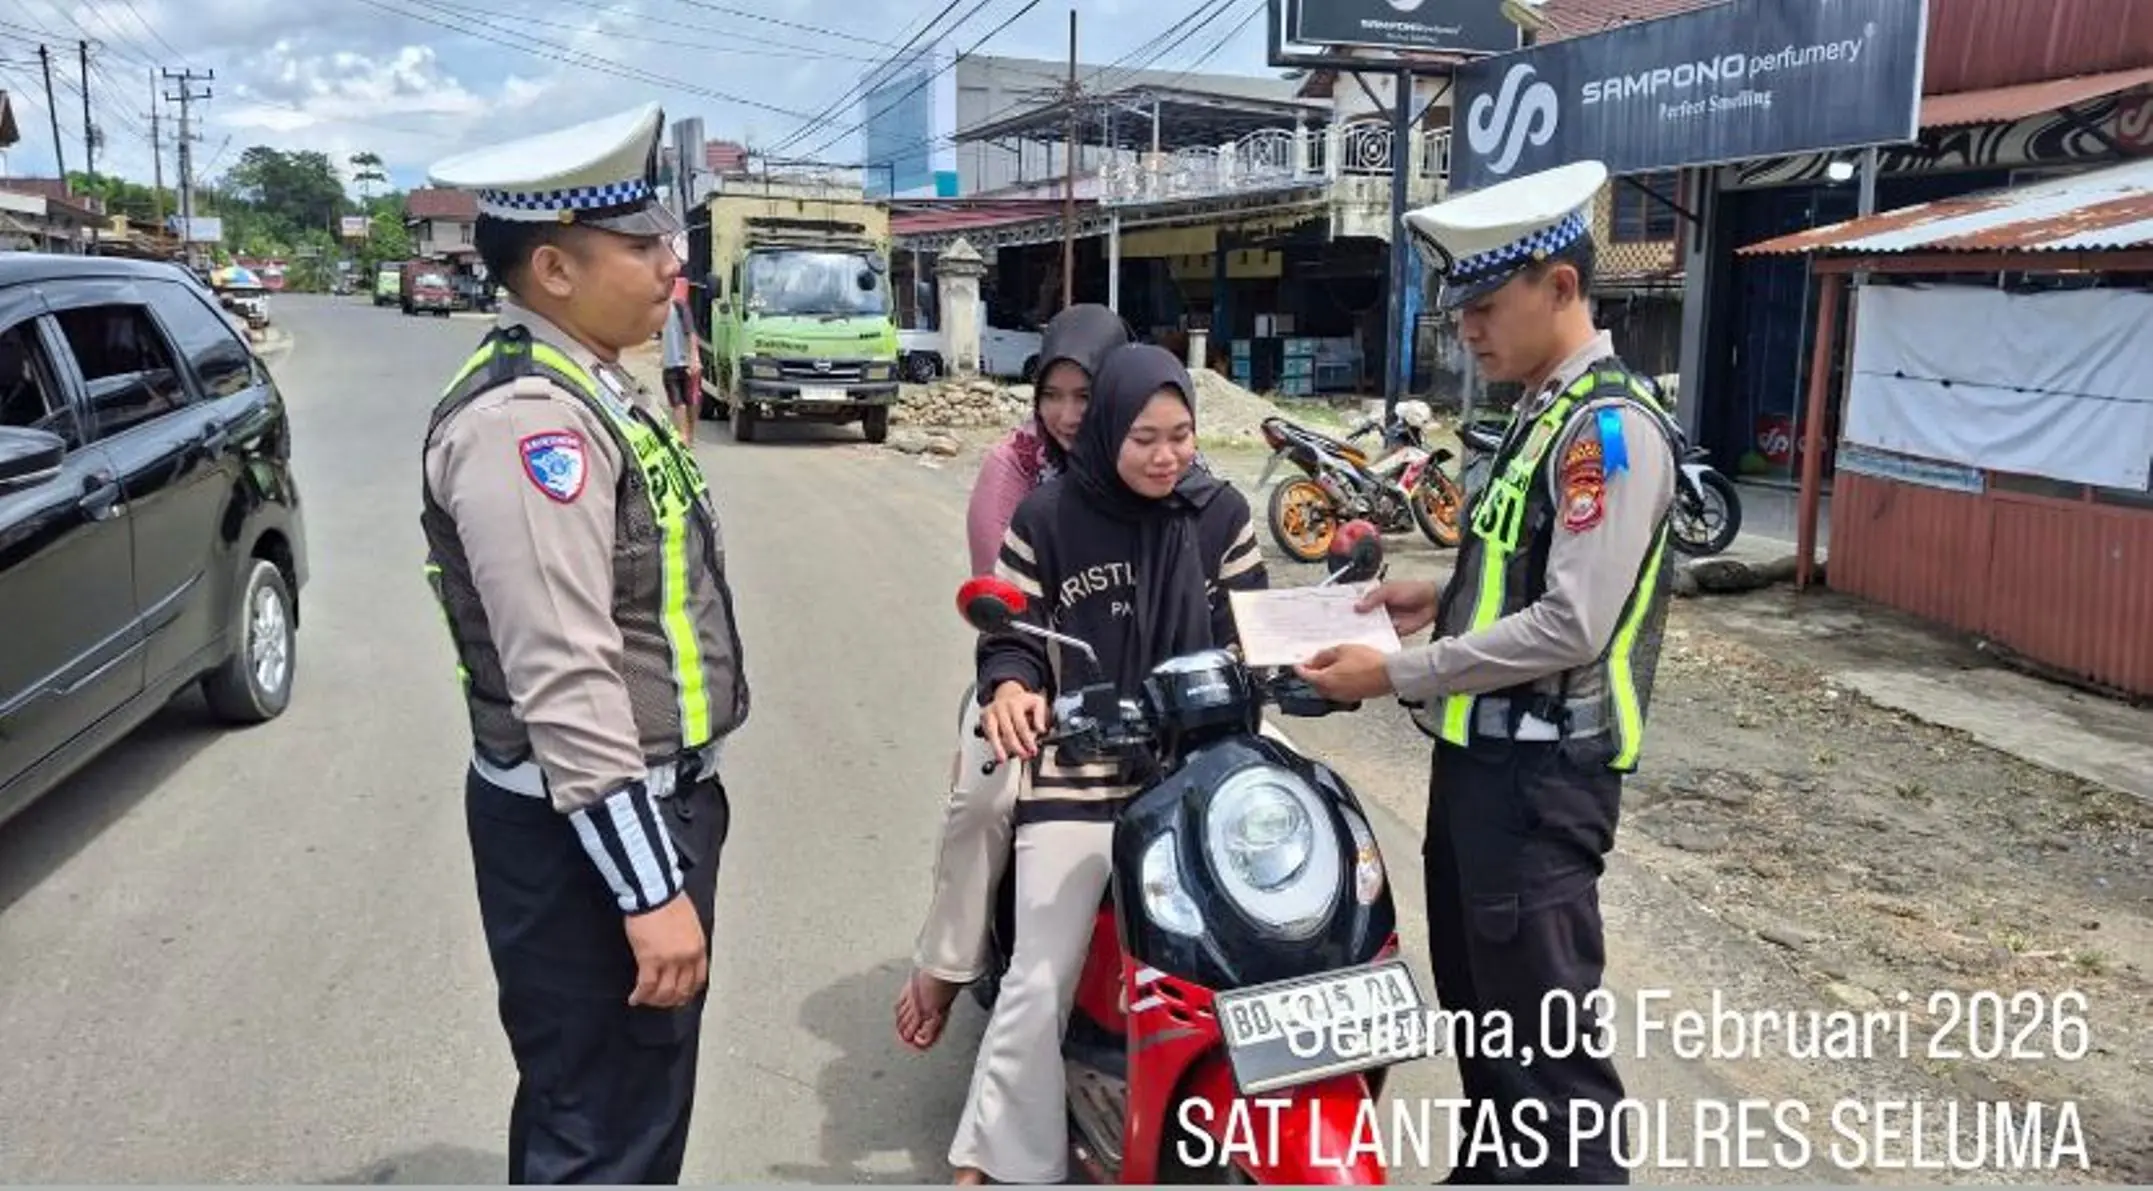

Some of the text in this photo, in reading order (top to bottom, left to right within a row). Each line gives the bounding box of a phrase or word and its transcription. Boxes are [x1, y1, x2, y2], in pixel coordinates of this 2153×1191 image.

[1581, 37, 1862, 105] SAMPONO perfumery
[1659, 100, 1706, 121] Perfect
